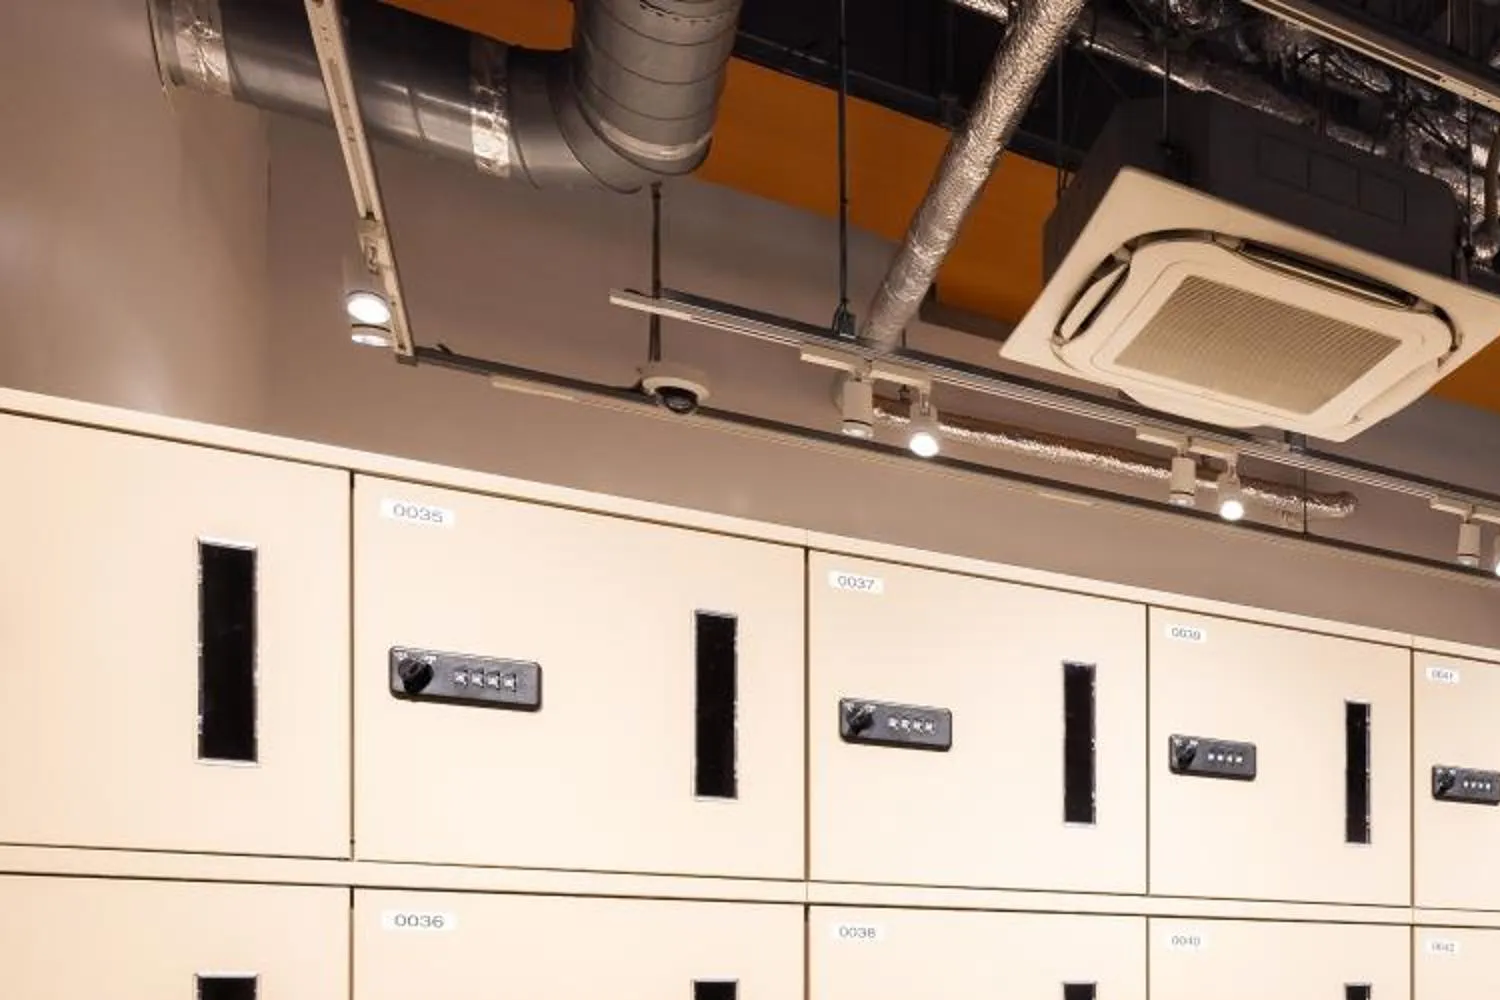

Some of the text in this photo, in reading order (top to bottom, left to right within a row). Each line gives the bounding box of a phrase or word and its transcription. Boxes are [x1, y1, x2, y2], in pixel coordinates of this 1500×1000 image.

[393, 502, 444, 523] 0035
[837, 575, 875, 590] 0037
[394, 913, 445, 929] 0036
[839, 926, 877, 939] 0038
